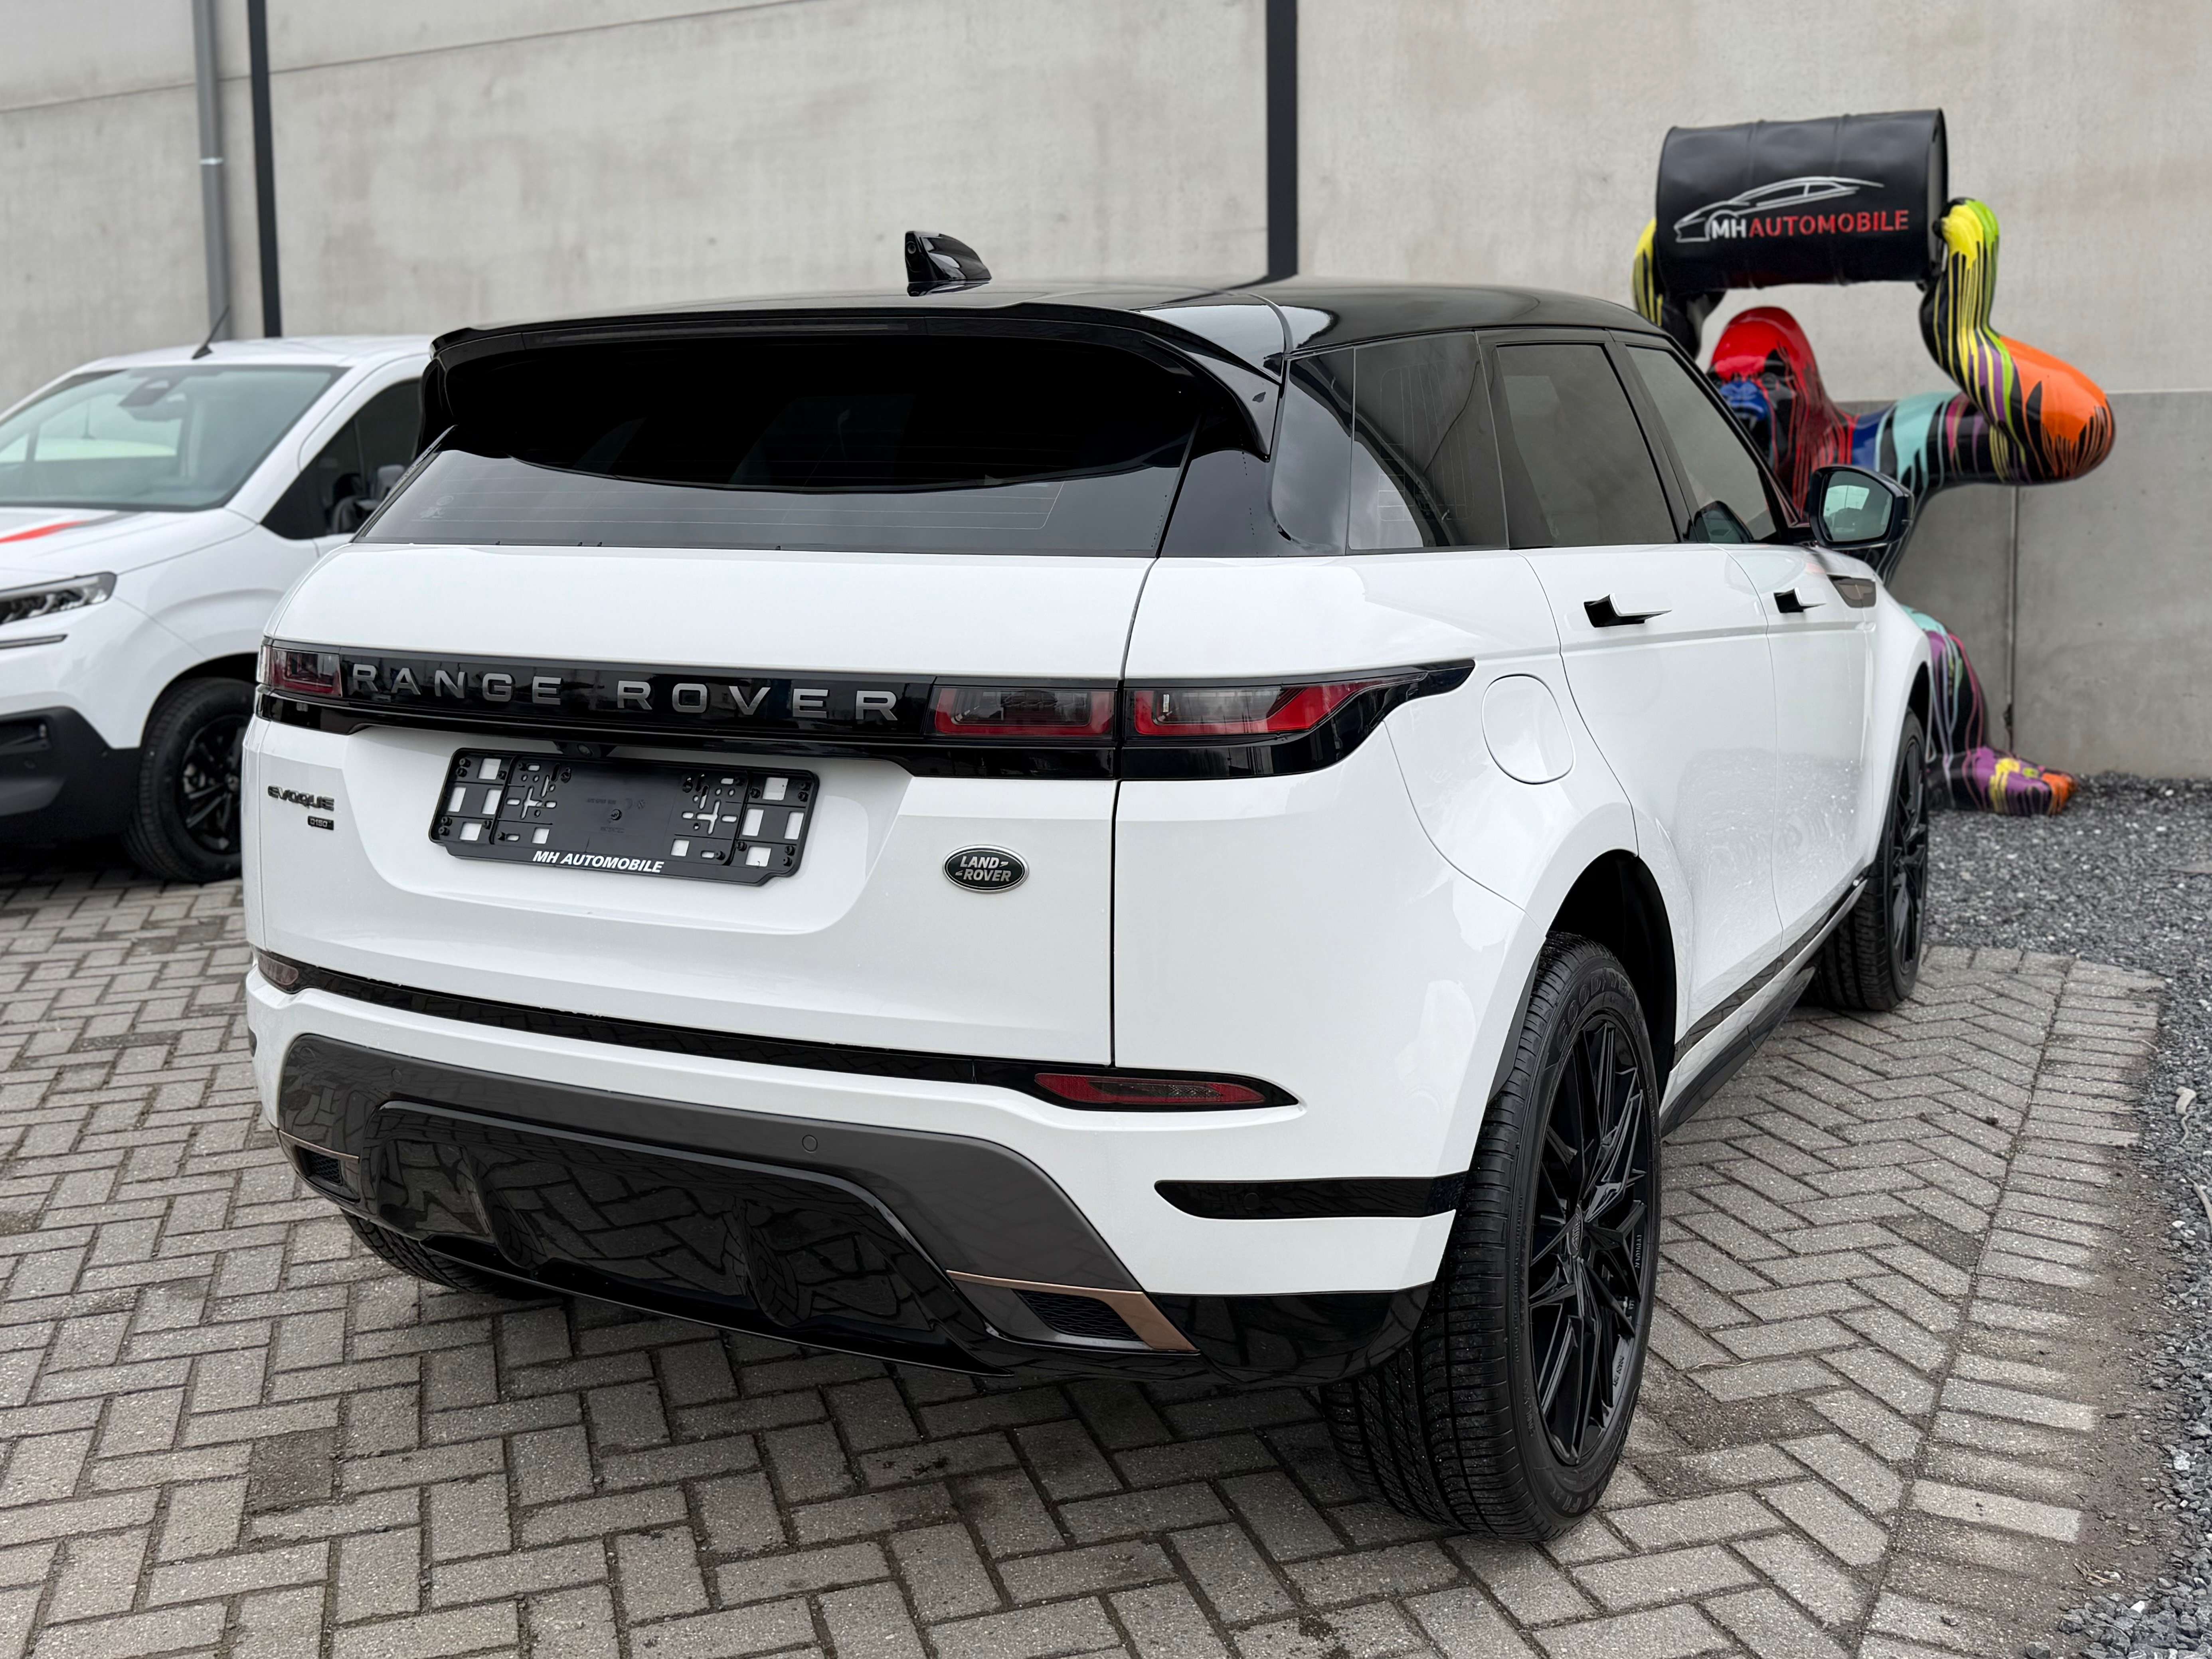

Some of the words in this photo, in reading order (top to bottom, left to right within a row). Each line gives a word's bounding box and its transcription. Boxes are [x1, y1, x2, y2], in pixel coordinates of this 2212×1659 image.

[352, 664, 561, 705] RANGE
[617, 680, 898, 721] ROVER
[268, 785, 334, 811] EVOQUE
[532, 850, 560, 863] MH
[560, 853, 664, 873] AUTOMOBILE
[960, 856, 998, 868] LAND
[963, 869, 1011, 882] ROVER
